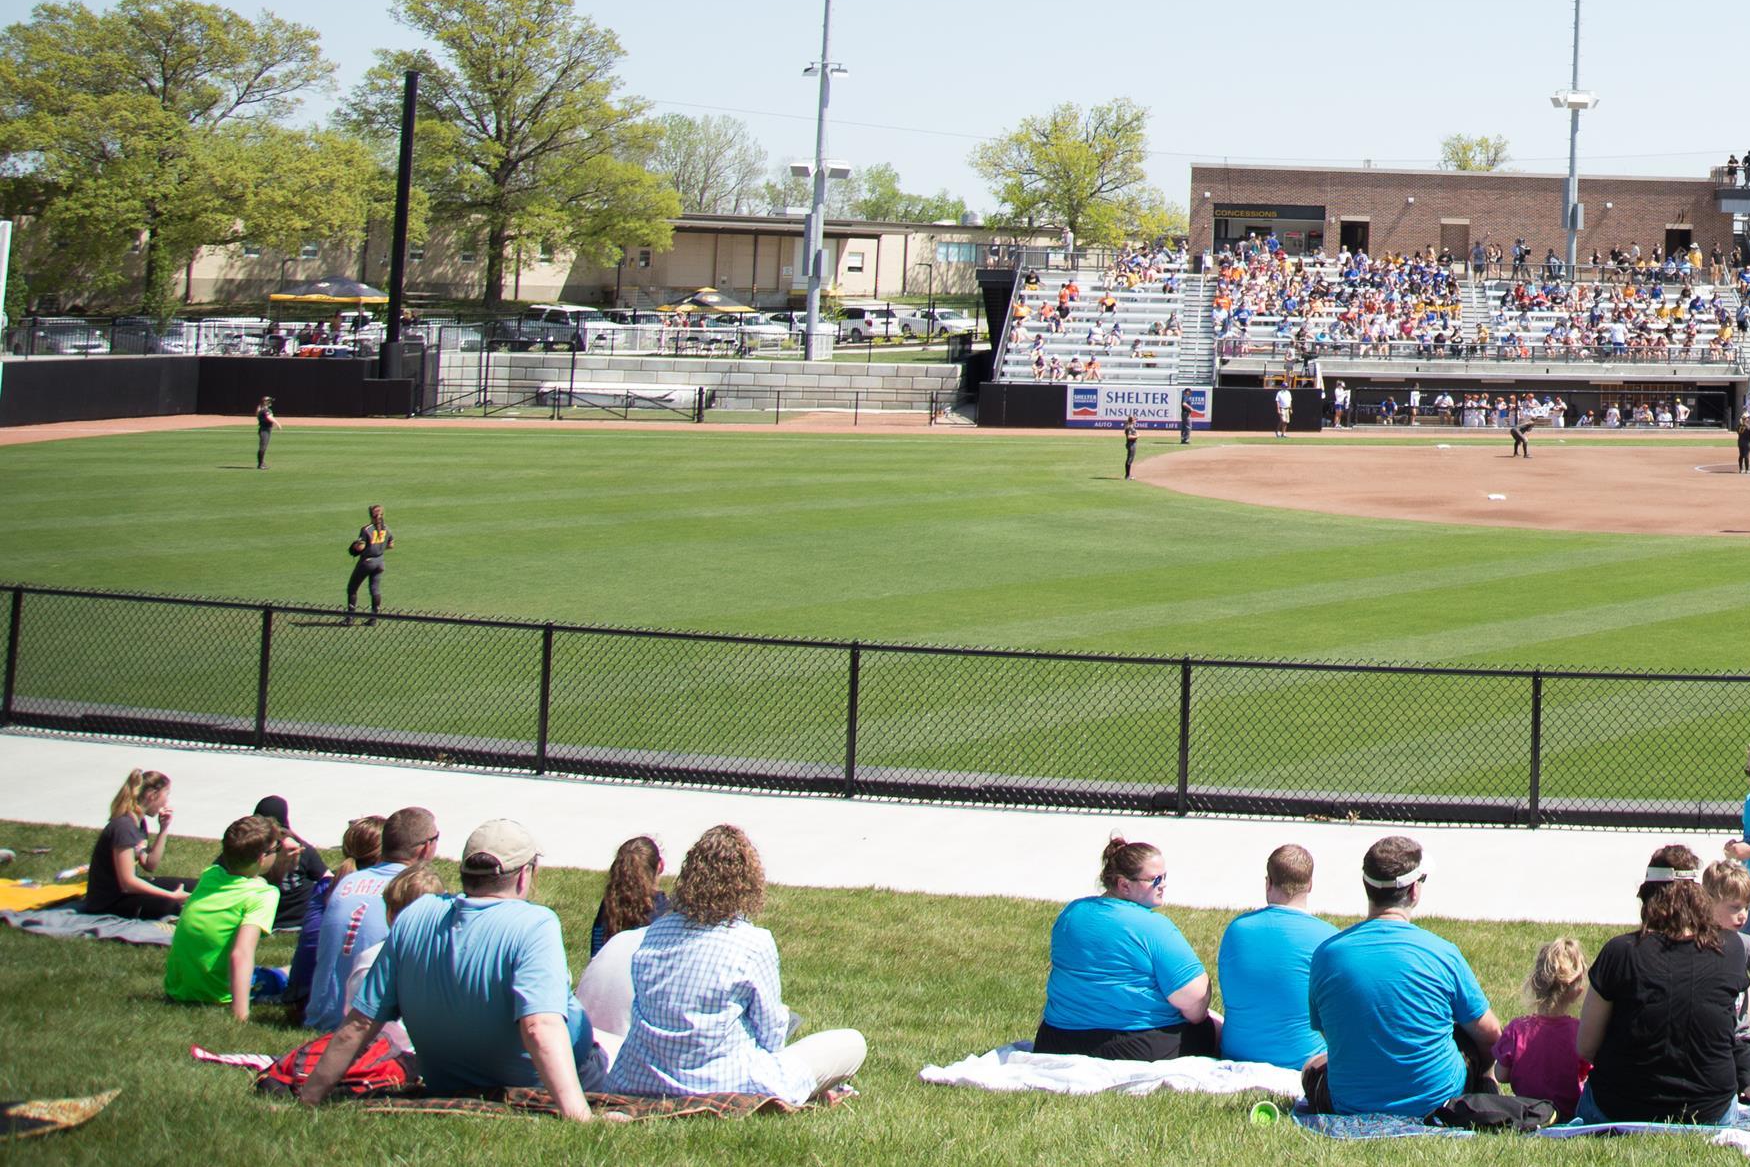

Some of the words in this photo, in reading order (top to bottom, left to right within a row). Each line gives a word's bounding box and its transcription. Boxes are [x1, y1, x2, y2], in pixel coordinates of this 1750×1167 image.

[1215, 209, 1277, 218] CONCESSIONS
[1106, 391, 1169, 405] SHELTER
[1105, 408, 1169, 418] INSURANCE
[340, 878, 385, 898] SMI
[343, 902, 368, 955] 1
